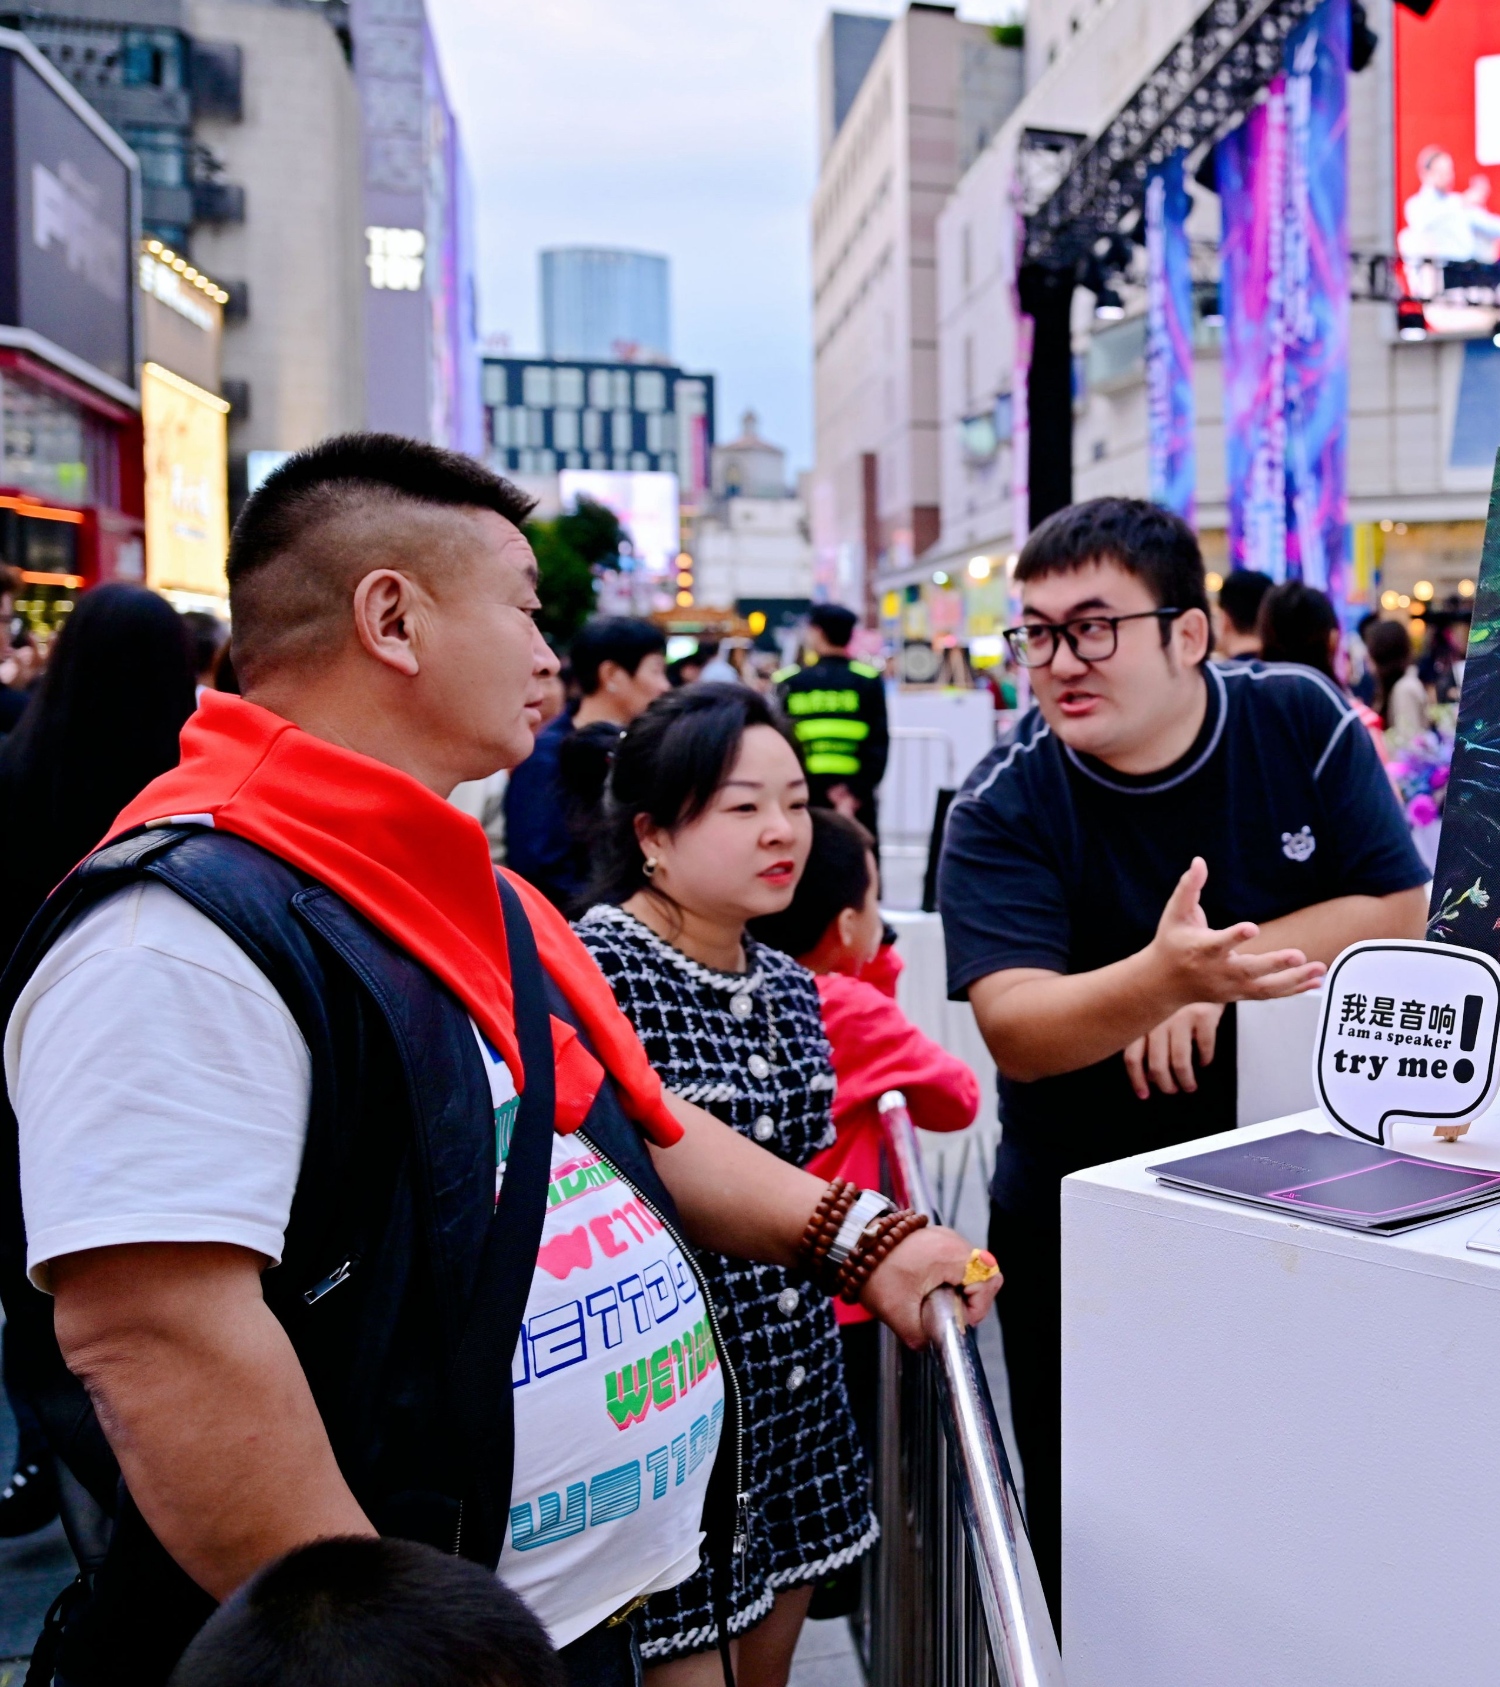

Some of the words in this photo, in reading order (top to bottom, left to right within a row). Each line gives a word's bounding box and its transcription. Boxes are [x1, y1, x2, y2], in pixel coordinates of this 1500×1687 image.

[365, 226, 425, 257] TOP
[365, 255, 424, 291] TOY
[1341, 993, 1456, 1035] 我是音响
[1338, 1023, 1344, 1036] I
[1348, 1027, 1370, 1039] am
[1374, 1030, 1382, 1040] a
[1387, 1032, 1452, 1049] speaker
[1334, 1049, 1389, 1081] try
[1397, 1057, 1448, 1079] me
